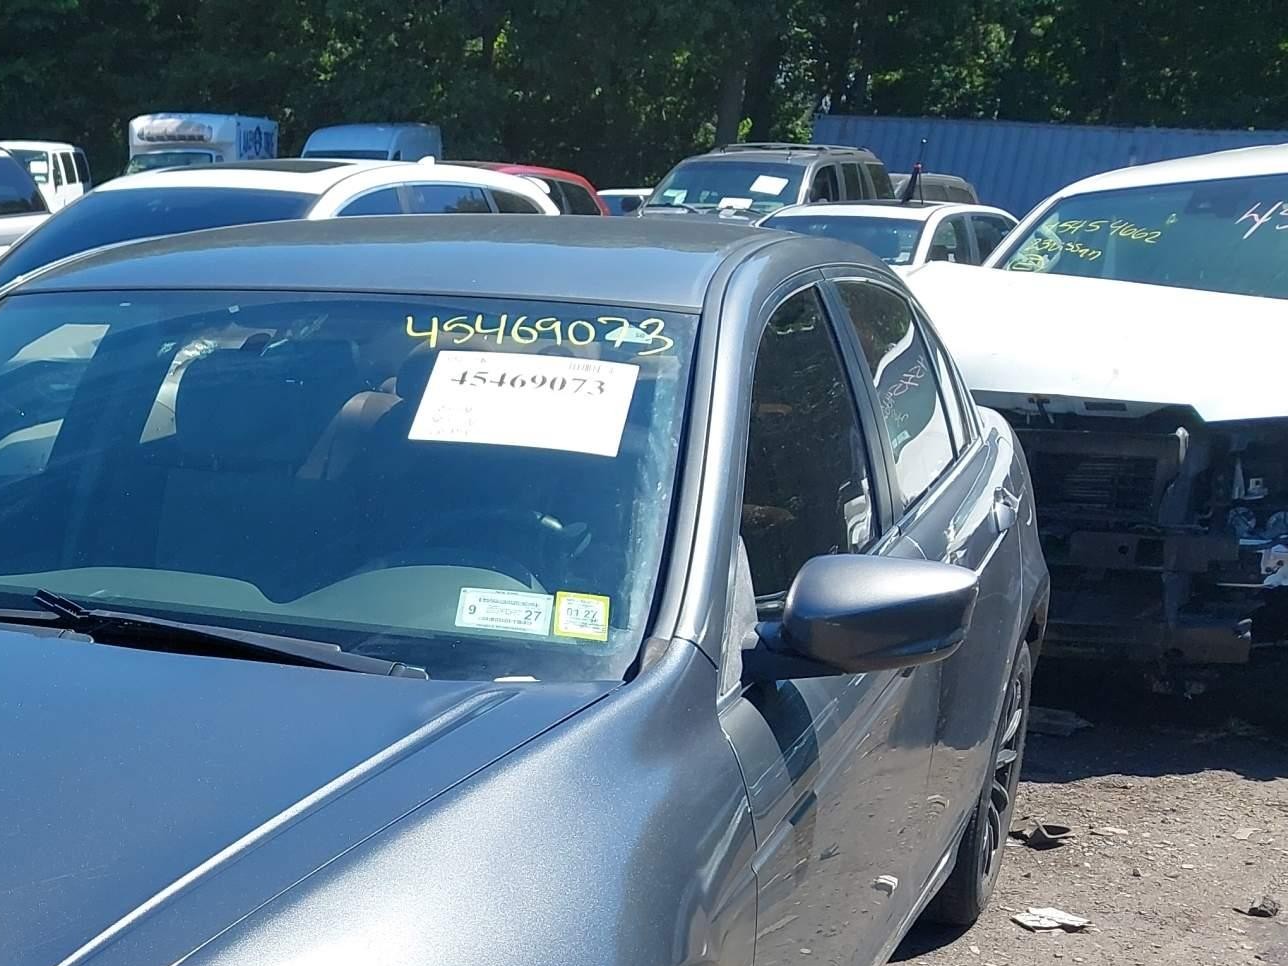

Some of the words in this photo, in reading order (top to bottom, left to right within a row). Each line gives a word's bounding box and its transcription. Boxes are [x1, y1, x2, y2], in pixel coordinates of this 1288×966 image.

[406, 314, 674, 356] 45469073
[451, 370, 606, 396] 45469073
[524, 609, 542, 622] 27
